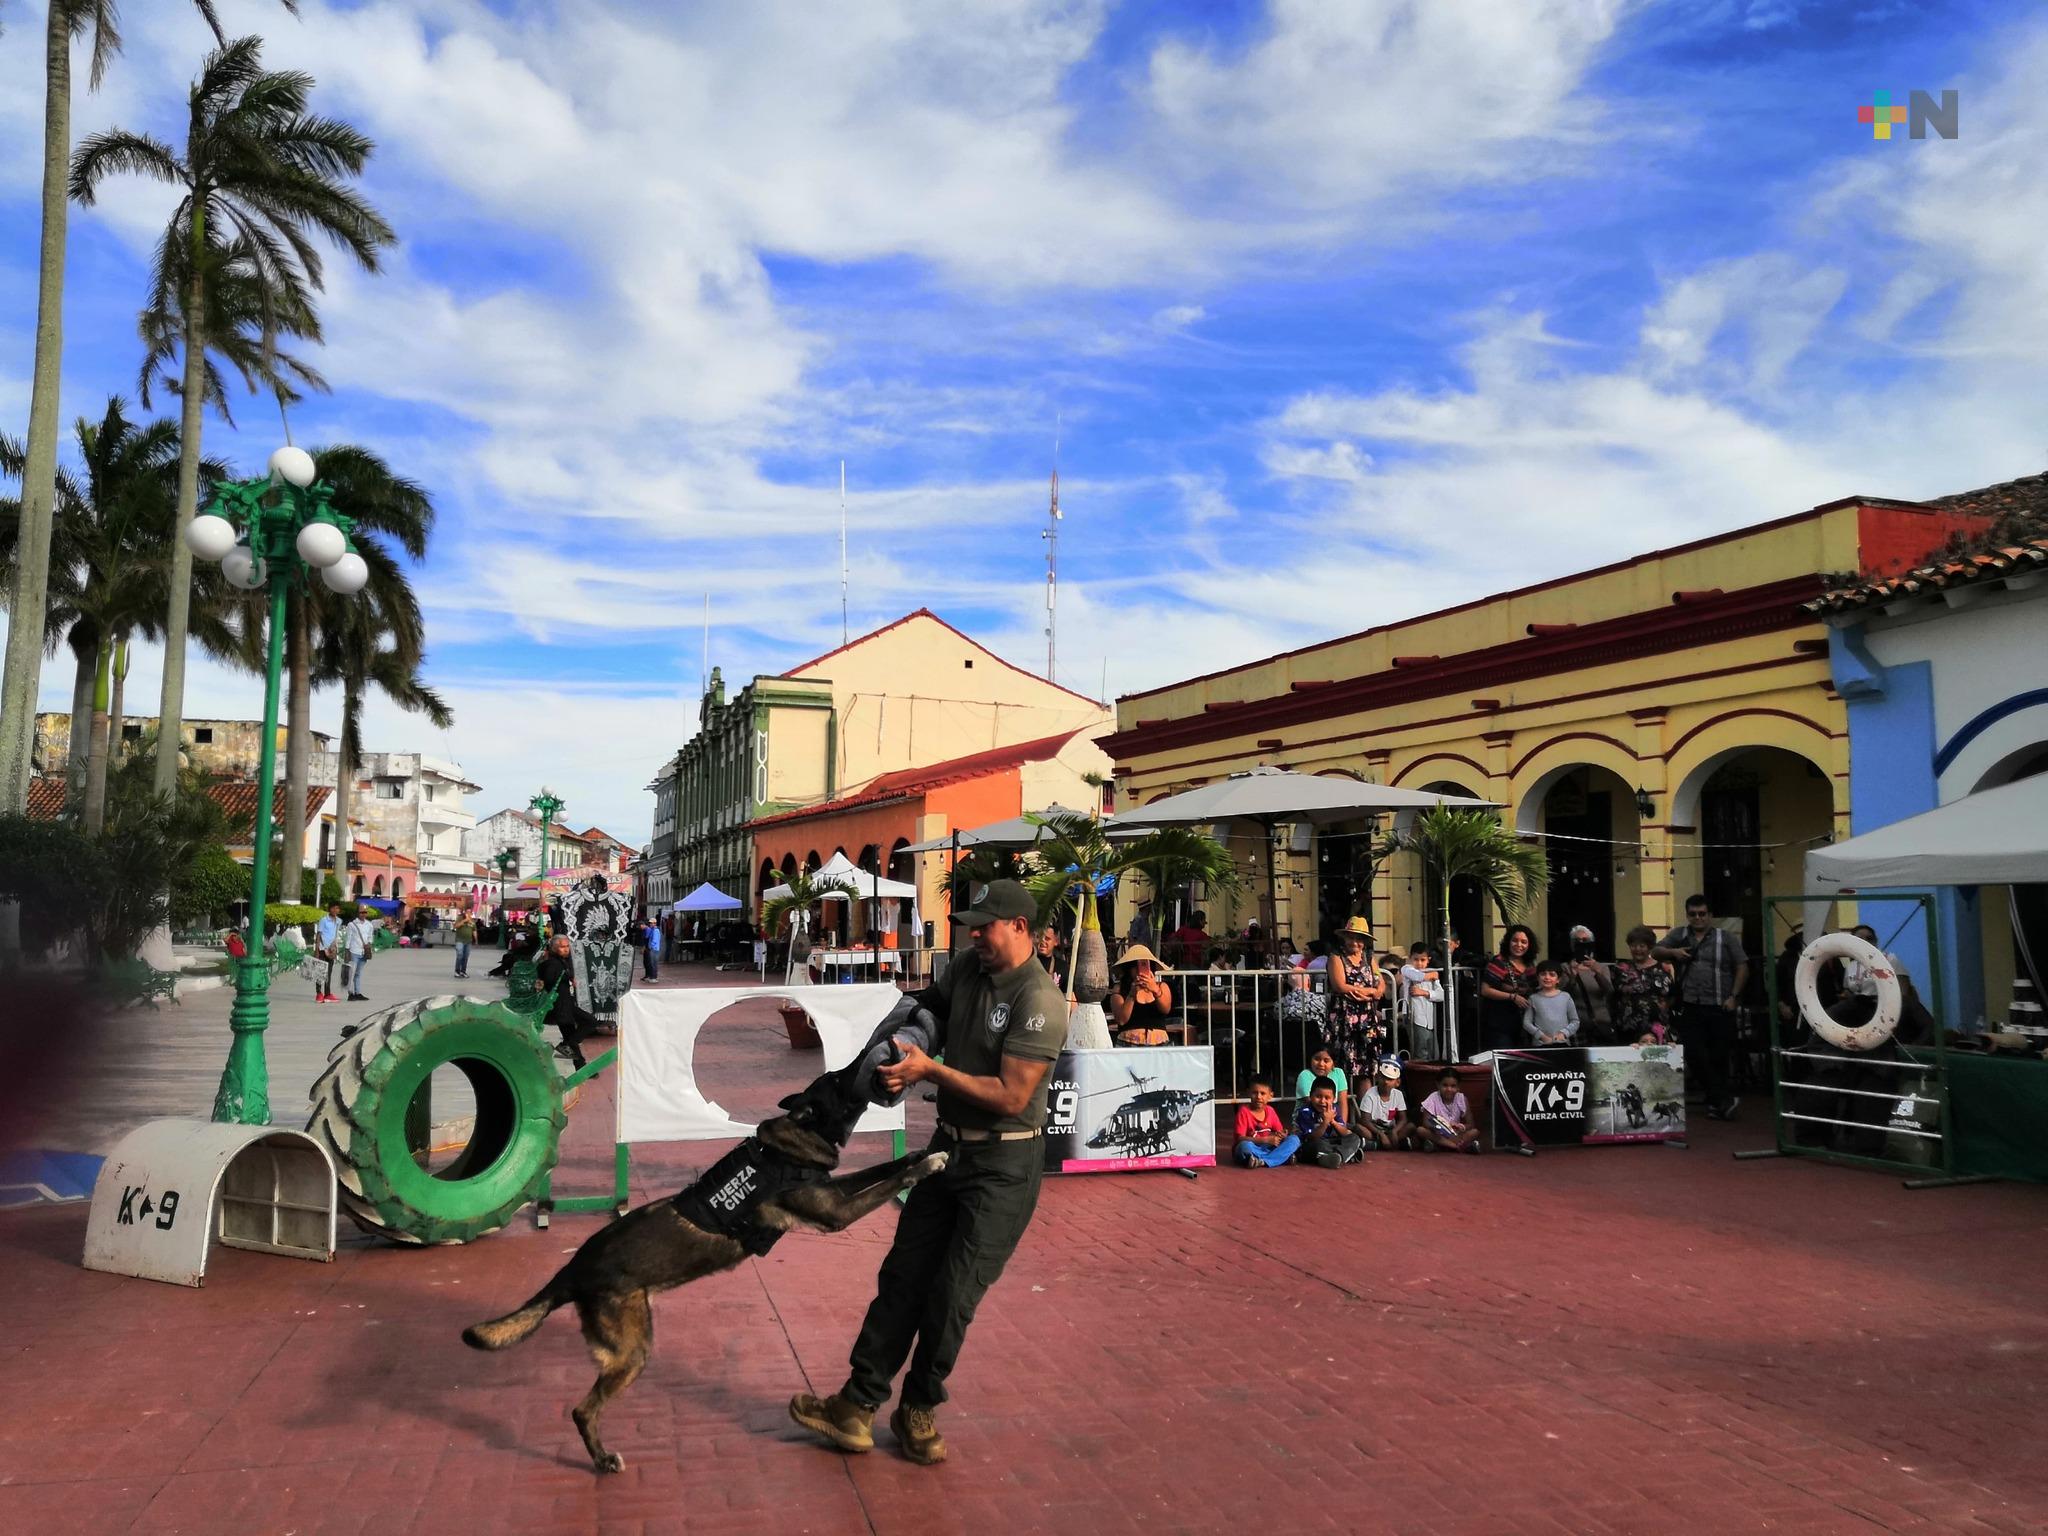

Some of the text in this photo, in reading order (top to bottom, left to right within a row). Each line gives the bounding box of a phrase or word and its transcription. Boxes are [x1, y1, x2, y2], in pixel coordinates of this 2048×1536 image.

[1525, 1070, 1586, 1081] COMPAÑIA
[1524, 1111, 1585, 1121] FUERZA CIVIL
[1047, 1126, 1080, 1135] CIVIL
[709, 1164, 757, 1209] FUERZA
[724, 1182, 757, 1211] CIVIL
